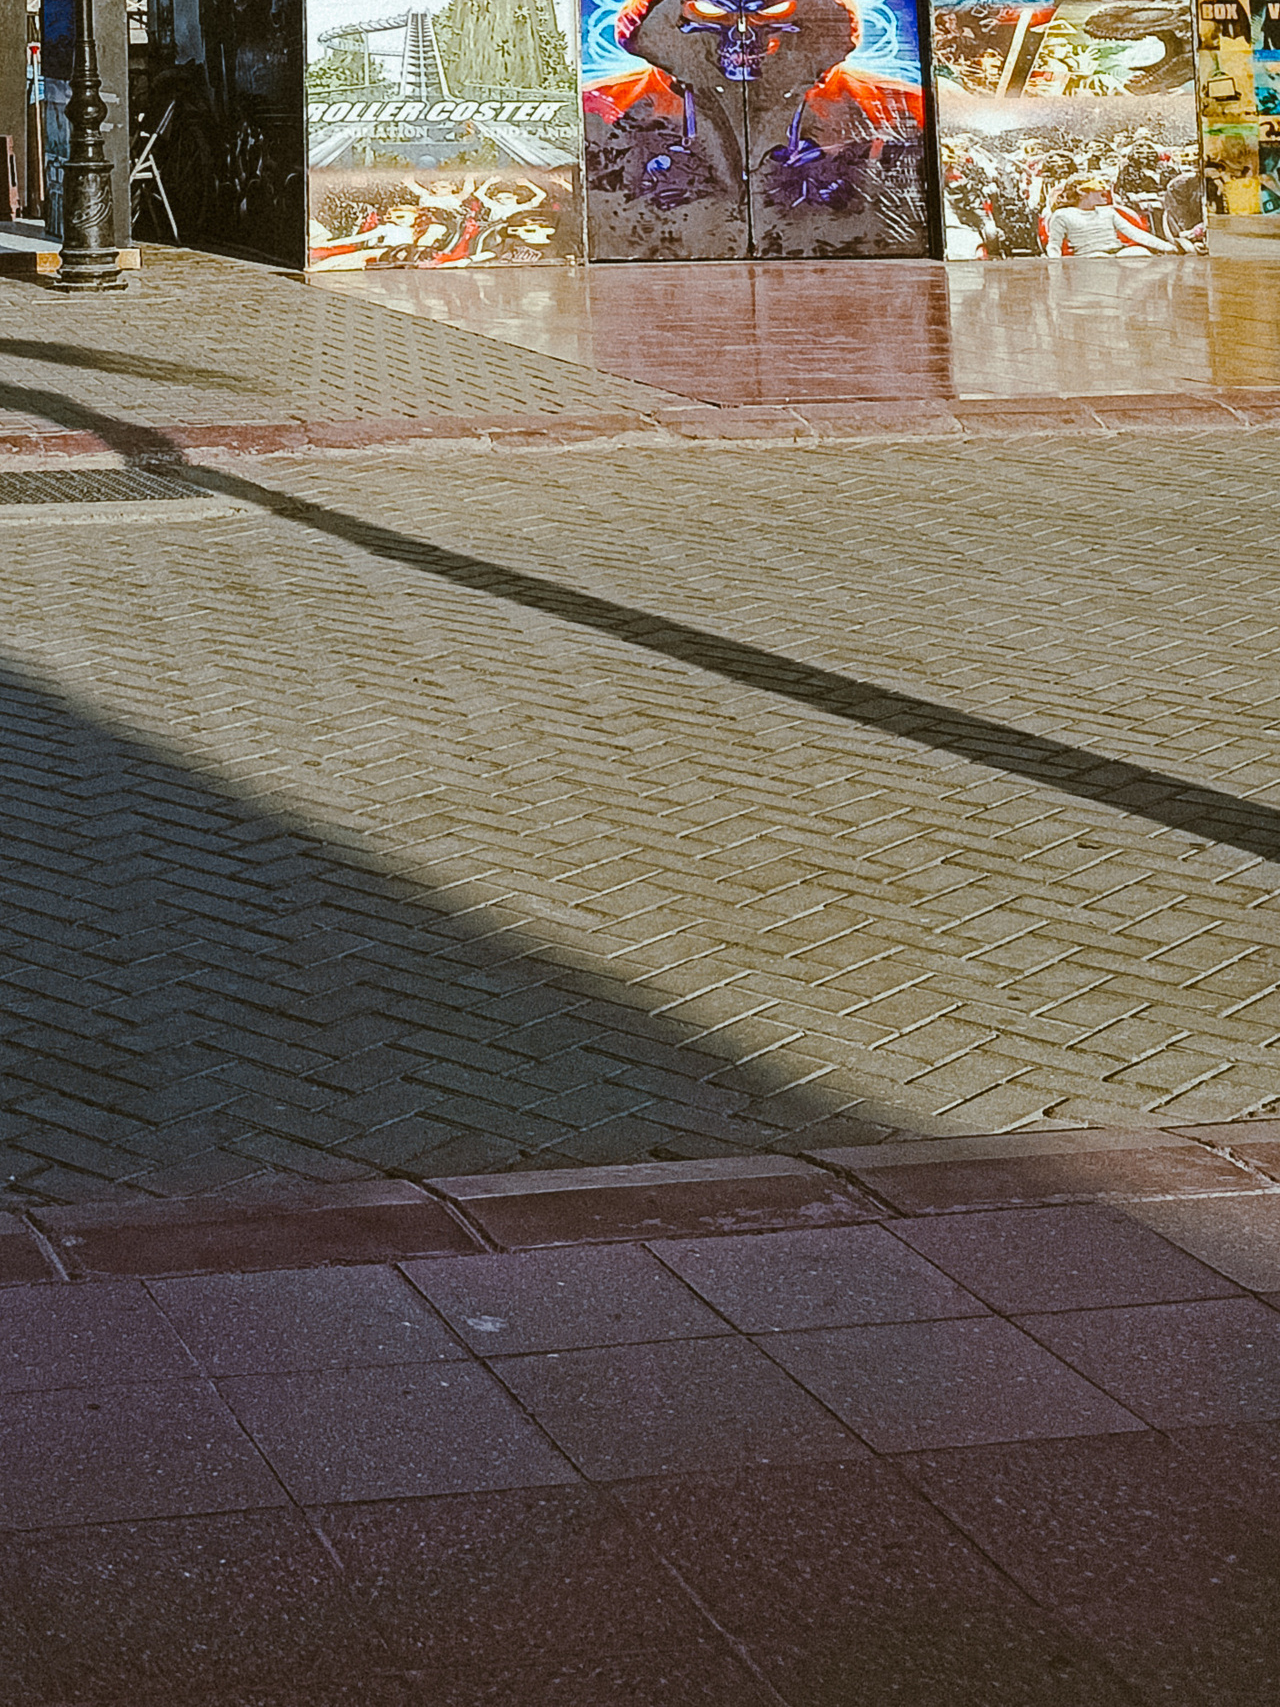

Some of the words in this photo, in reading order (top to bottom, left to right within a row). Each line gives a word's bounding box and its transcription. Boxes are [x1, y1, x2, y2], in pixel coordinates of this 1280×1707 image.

[1201, 3, 1238, 20] BOX
[308, 101, 425, 122] ROLLER
[426, 101, 569, 122] COSTER
